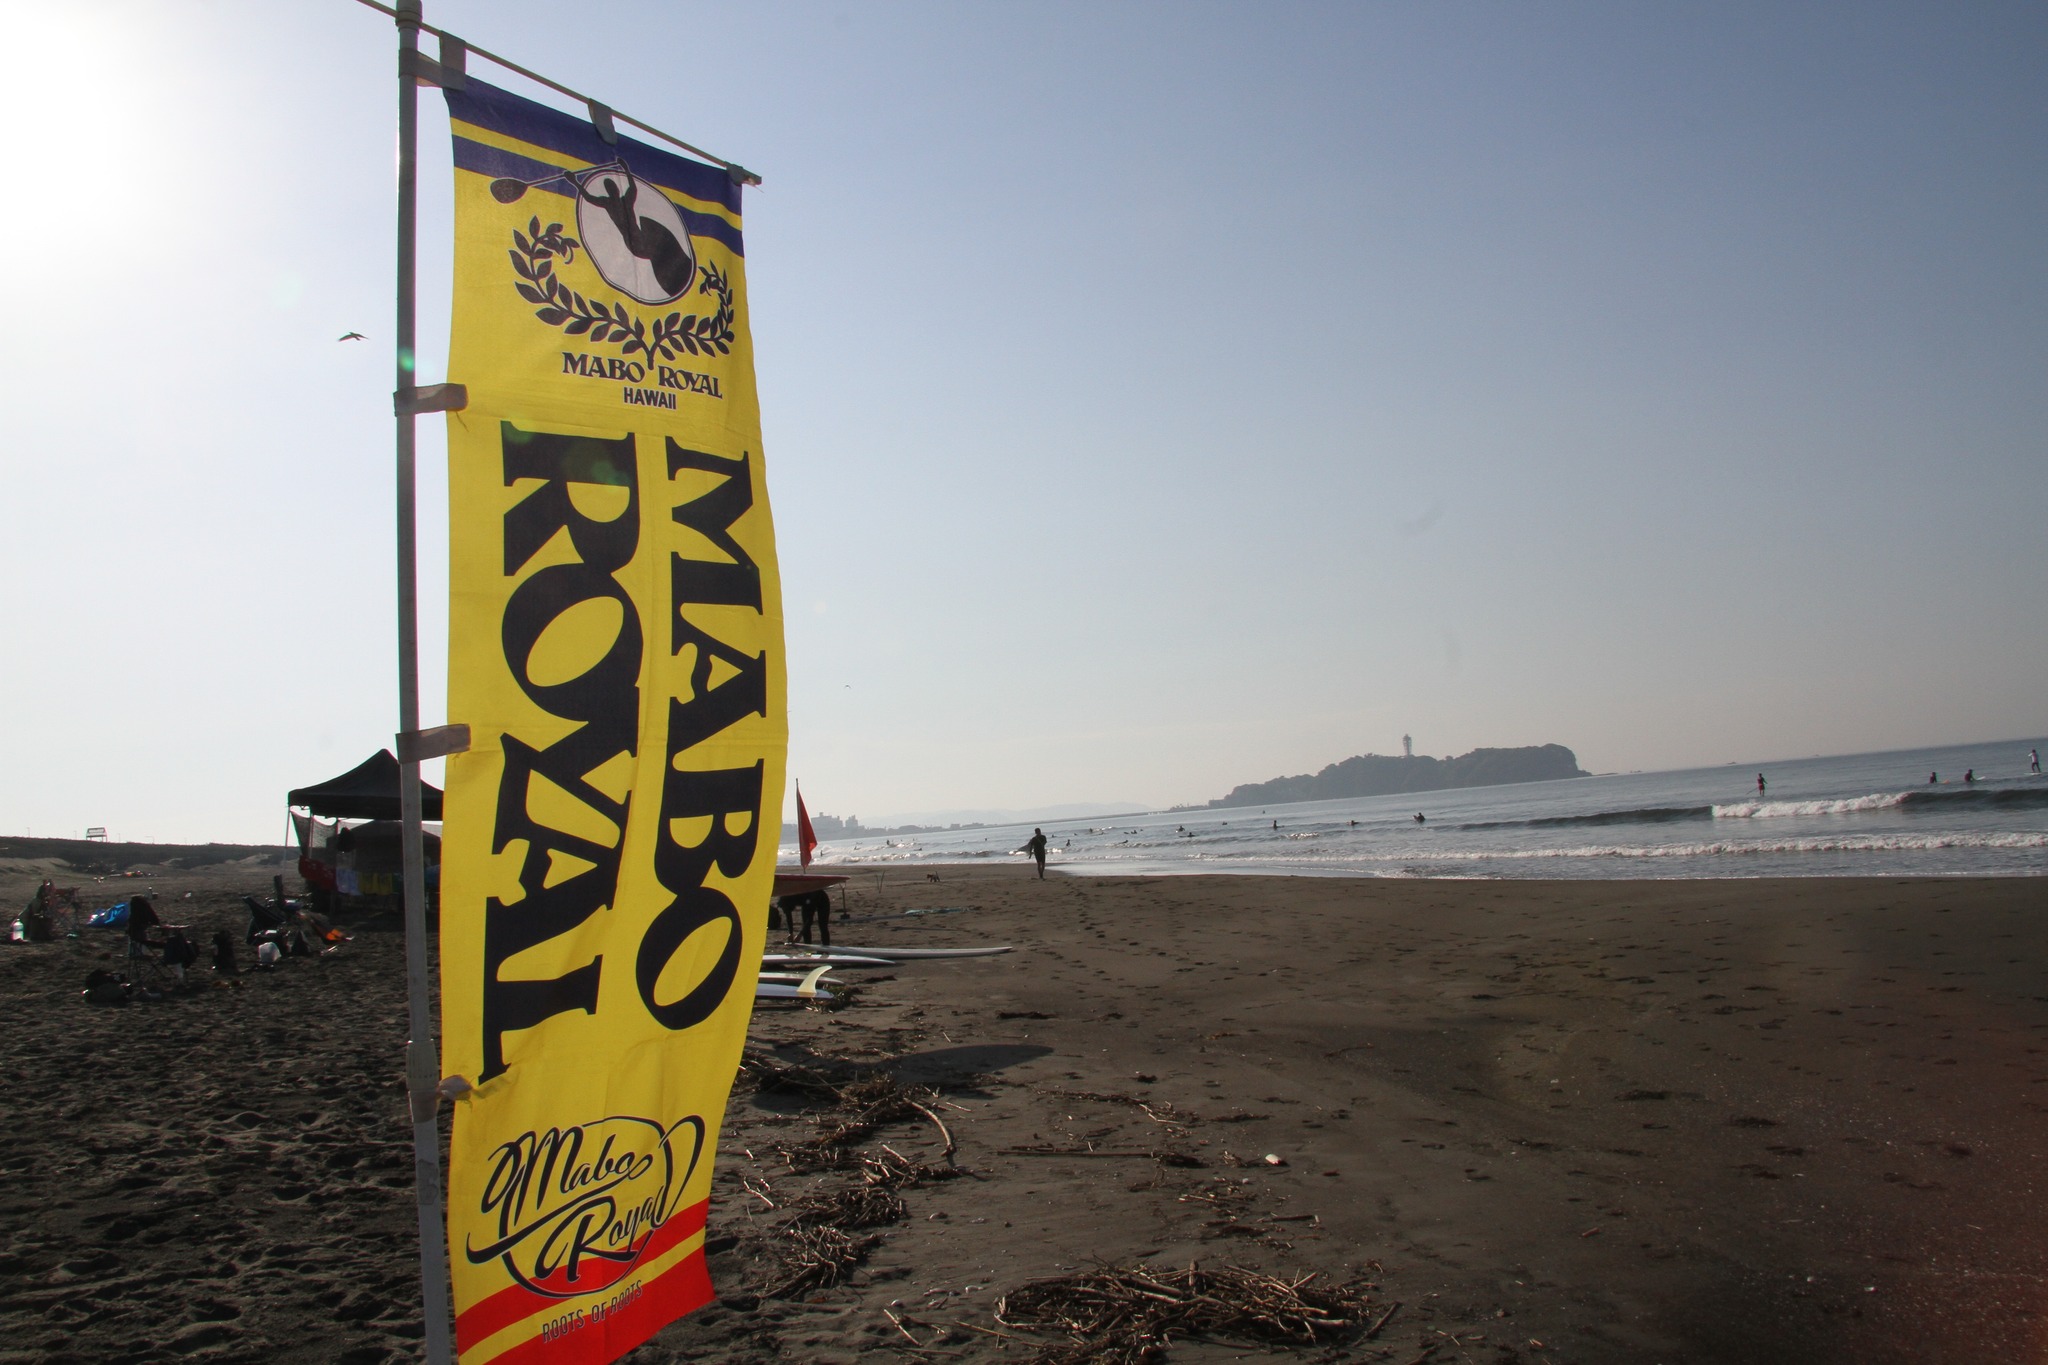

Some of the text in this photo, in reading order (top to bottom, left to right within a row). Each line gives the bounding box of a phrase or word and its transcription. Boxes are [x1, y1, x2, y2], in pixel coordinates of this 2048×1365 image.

[562, 352, 722, 399] MABO ROYAL
[624, 387, 677, 410] HAWAII
[478, 421, 643, 1085] ROYAL
[636, 436, 766, 1030] MABO
[481, 1126, 653, 1226] Mabo
[542, 1280, 643, 1343] ROOTS OF ROOTS
